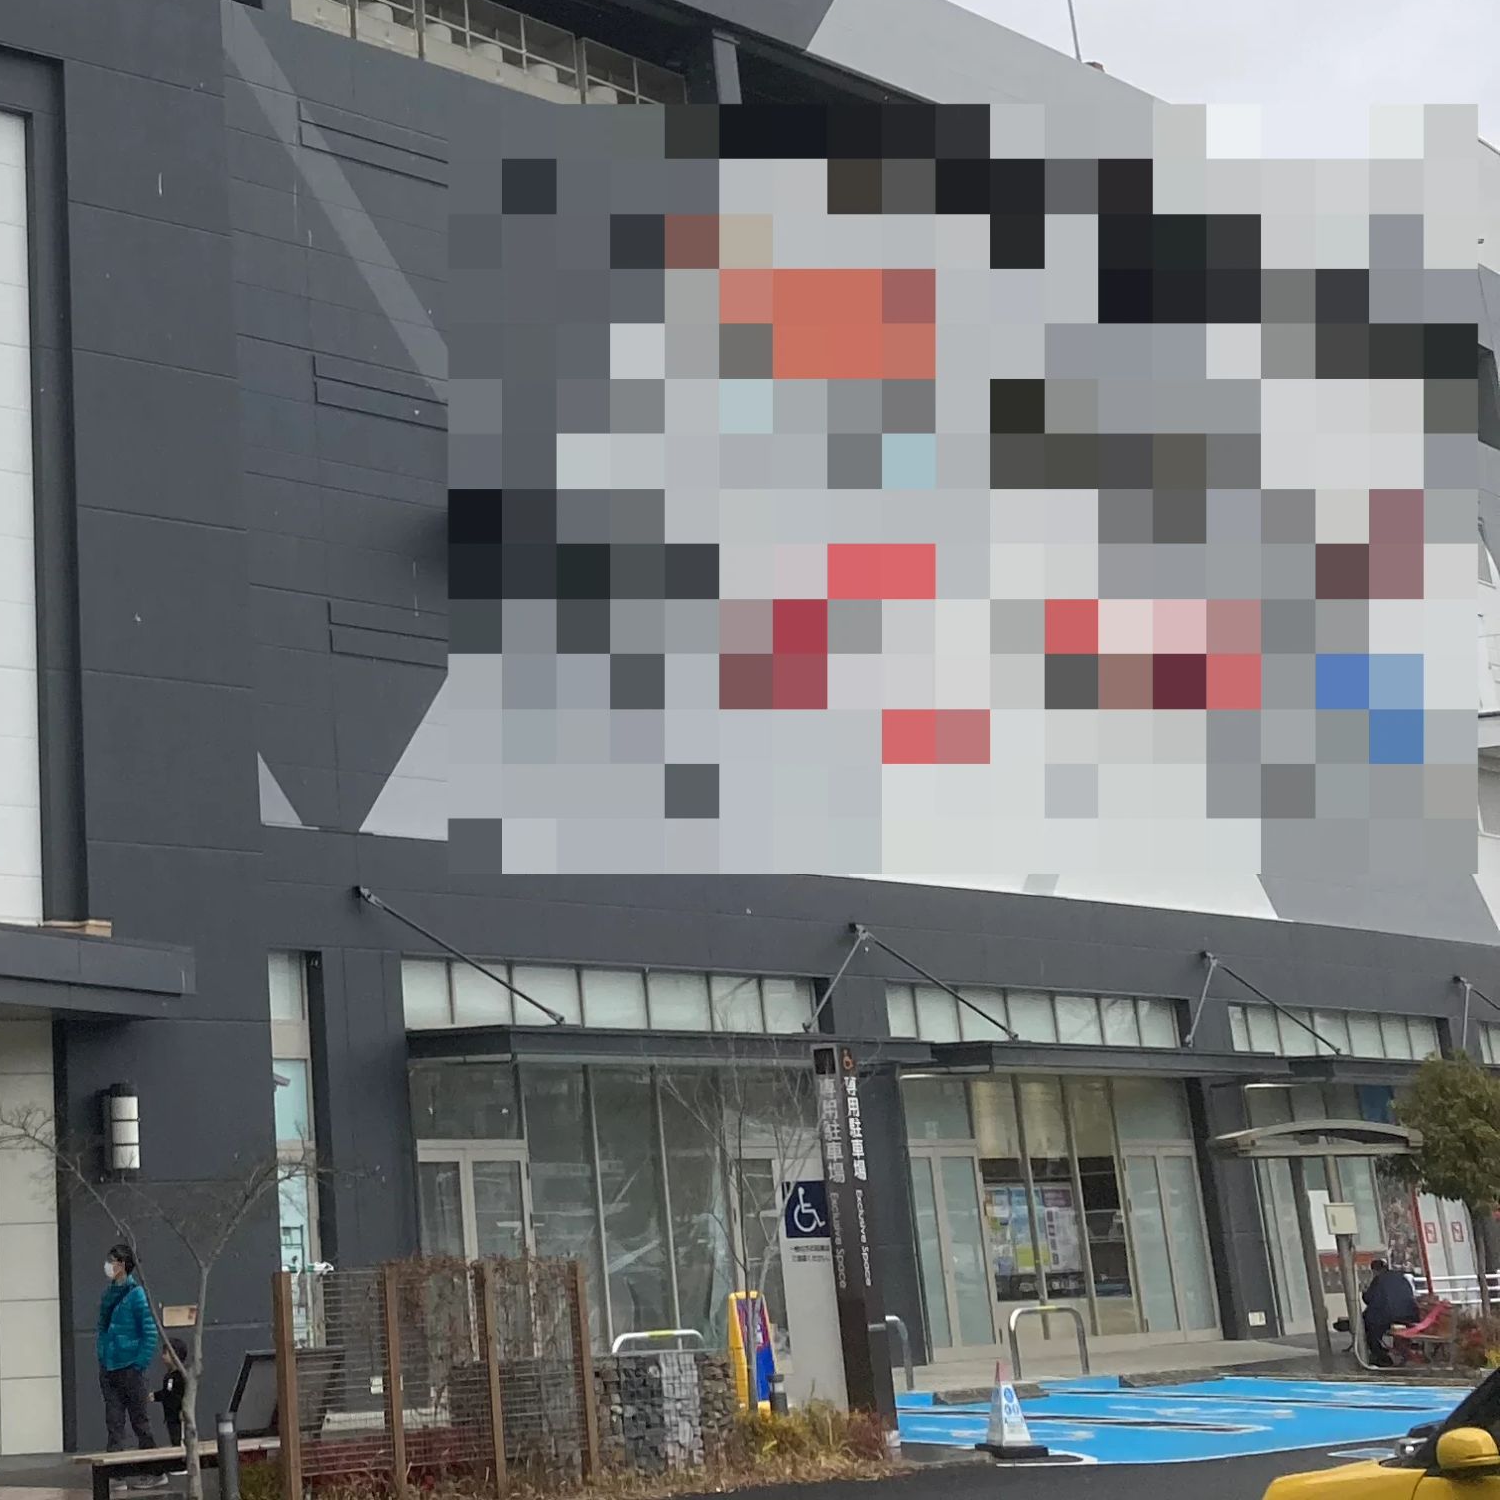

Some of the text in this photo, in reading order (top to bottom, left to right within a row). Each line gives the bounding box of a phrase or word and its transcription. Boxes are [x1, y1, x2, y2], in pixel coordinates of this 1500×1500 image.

[843, 1076, 867, 1180] 専用駐車場
[836, 1248, 847, 1288] Space
[861, 1246, 872, 1286] Space
